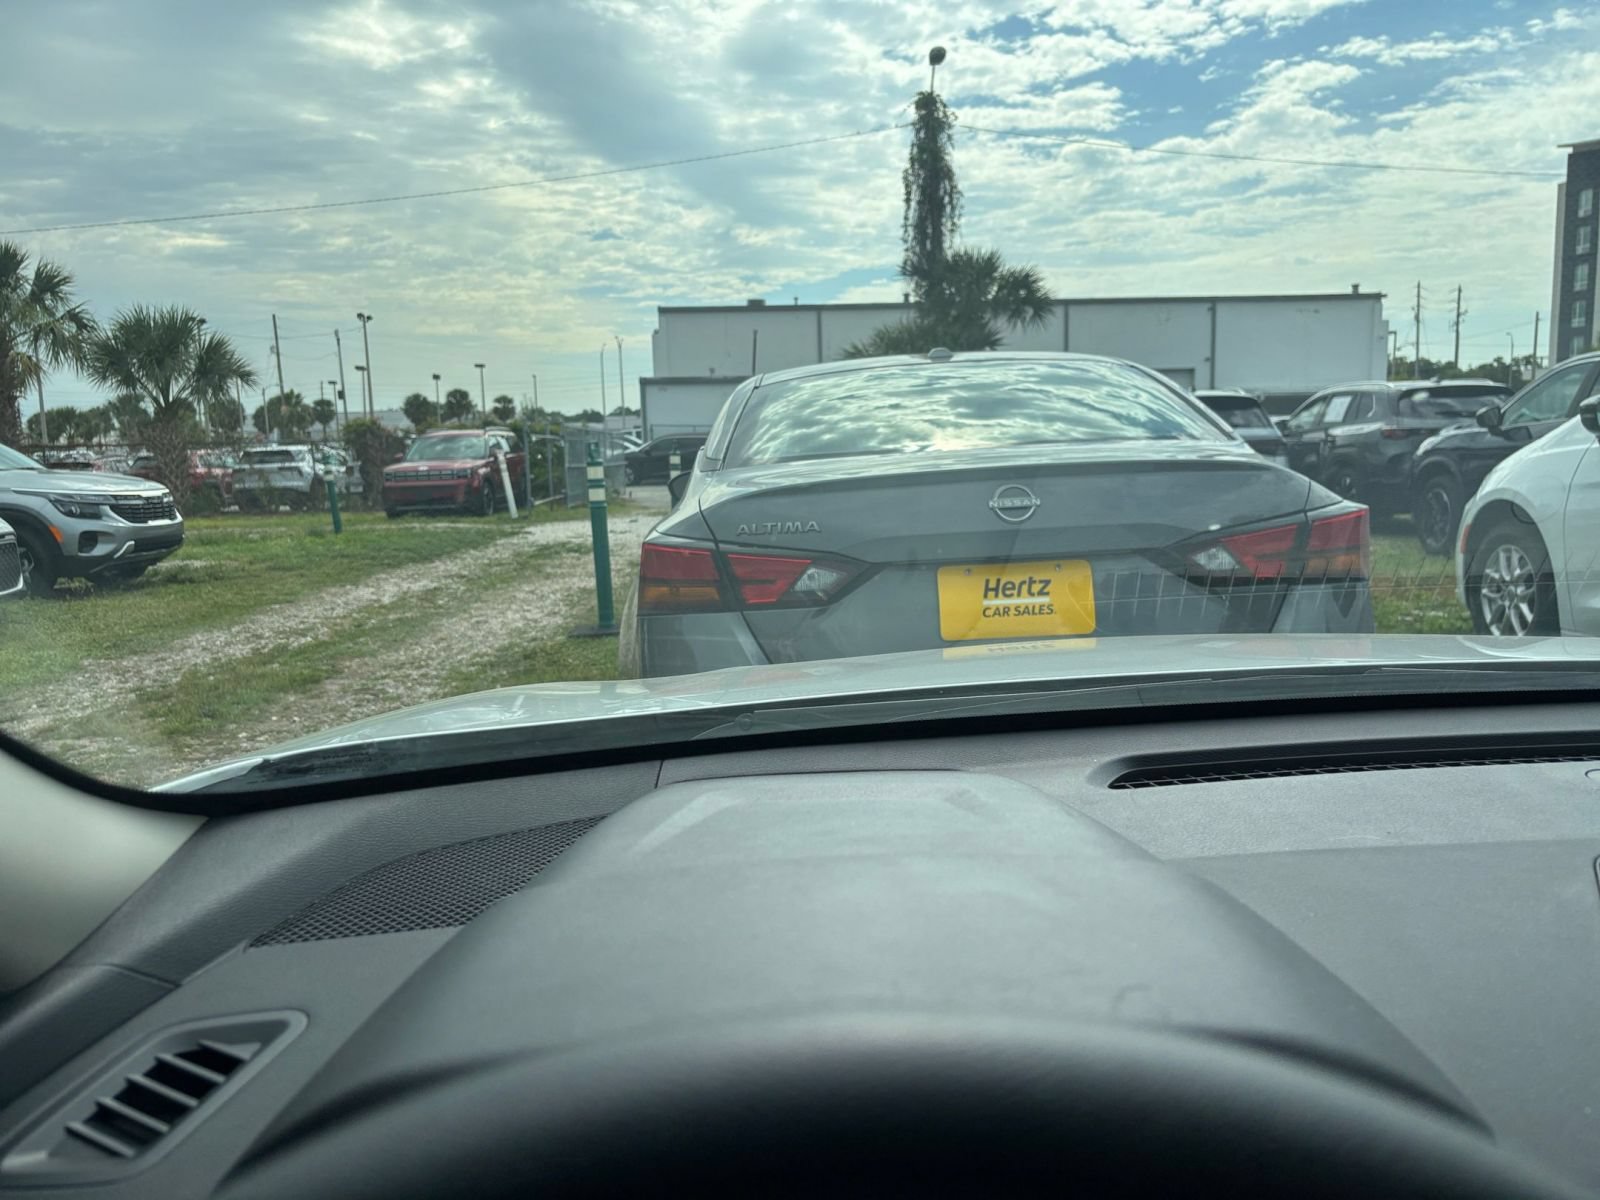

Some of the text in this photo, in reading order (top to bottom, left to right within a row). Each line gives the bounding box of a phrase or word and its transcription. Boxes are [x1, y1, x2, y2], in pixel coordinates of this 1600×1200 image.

[988, 498, 1041, 508] NISSAN
[736, 520, 821, 536] ALTIMA
[983, 576, 1051, 599] Hertz
[982, 605, 1011, 618] CAR
